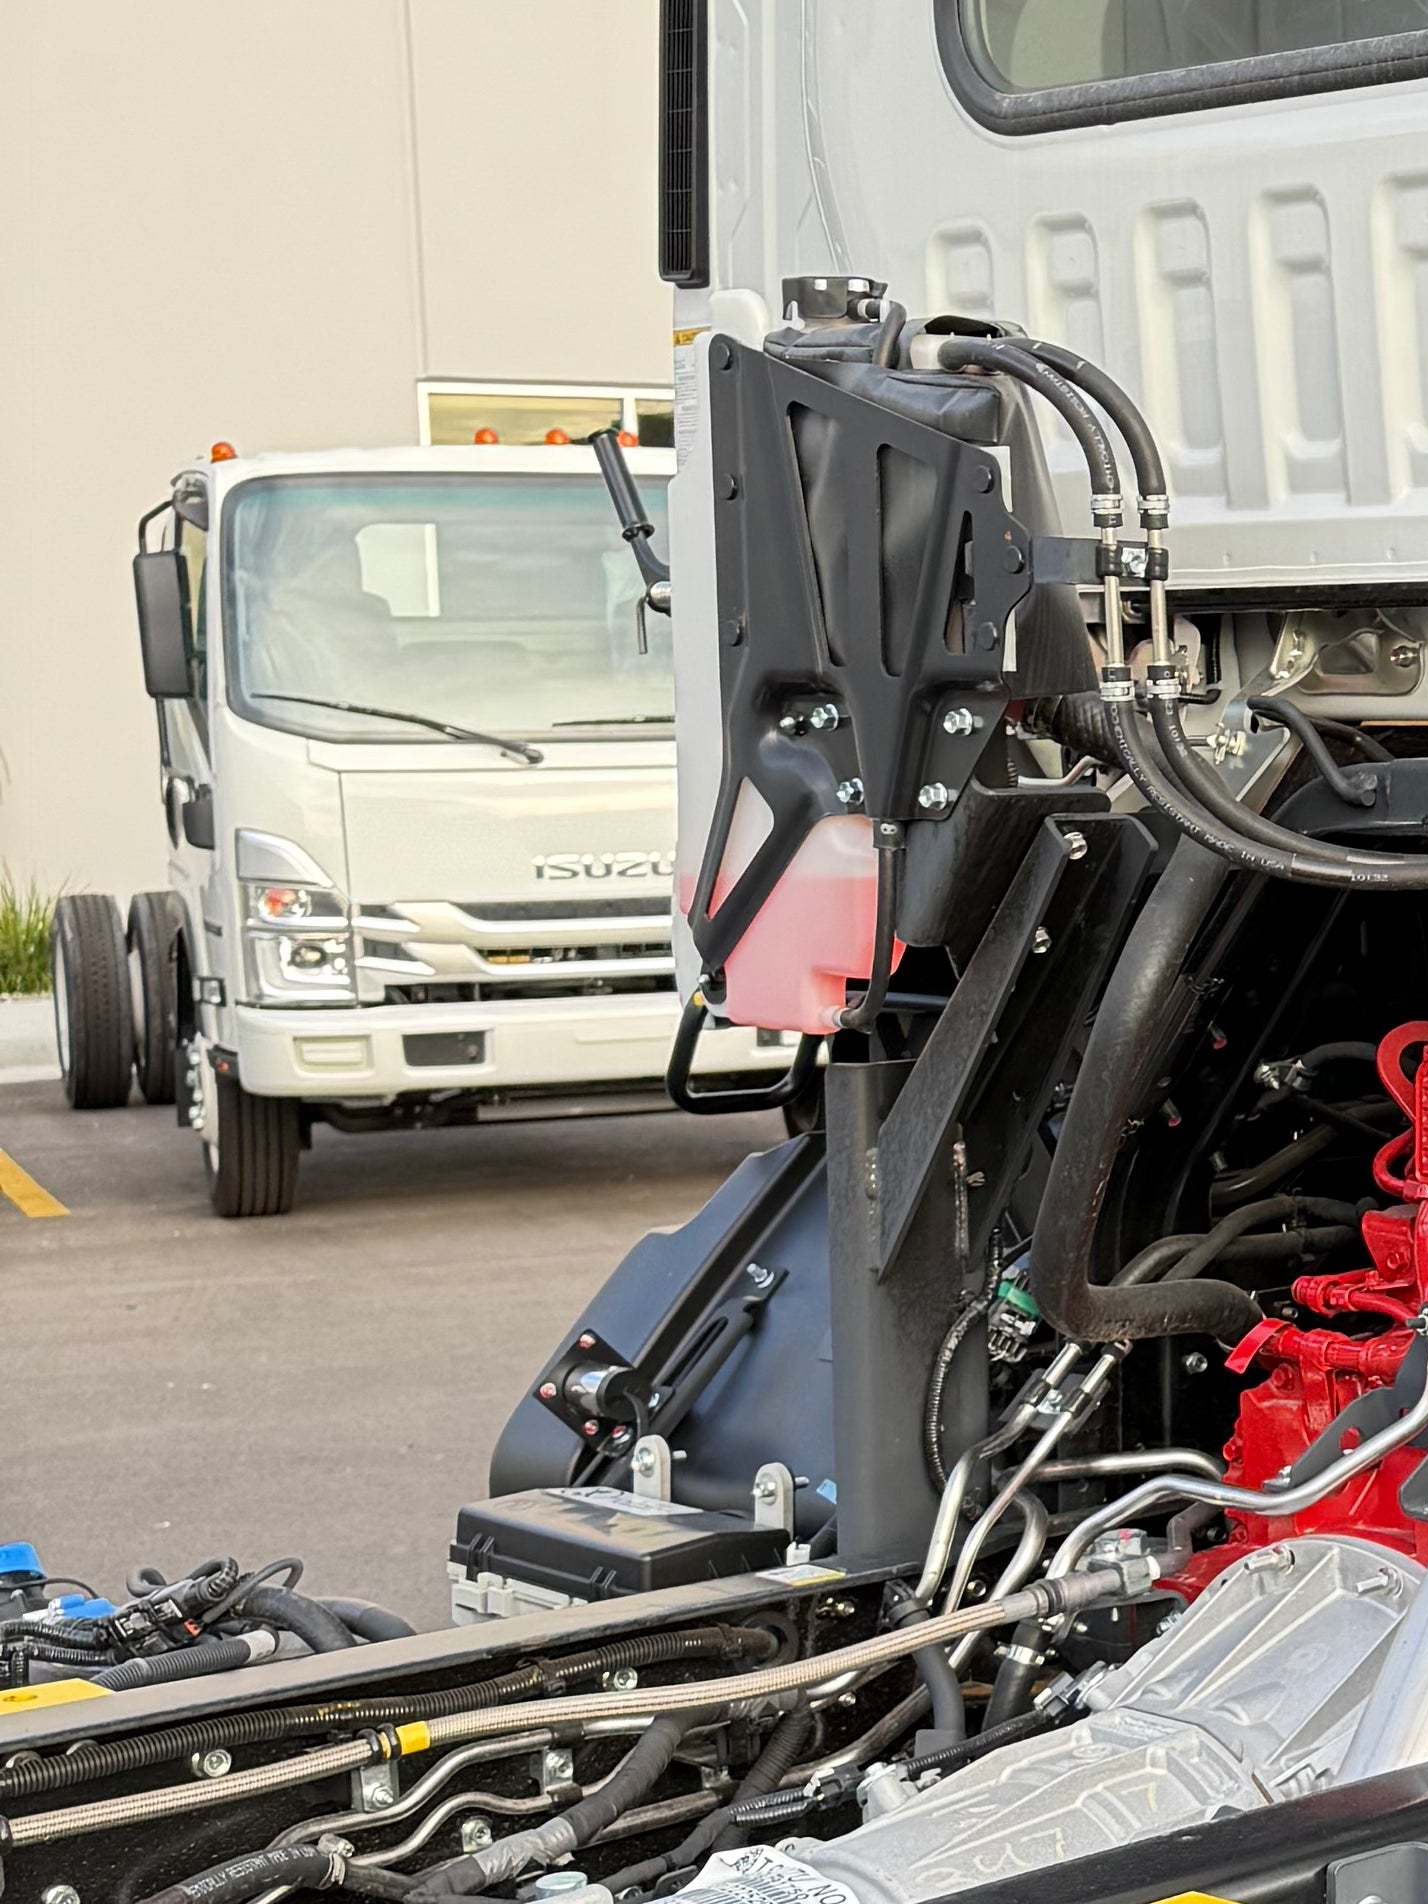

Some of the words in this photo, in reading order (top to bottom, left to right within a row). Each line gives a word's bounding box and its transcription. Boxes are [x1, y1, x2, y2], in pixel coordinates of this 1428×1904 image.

[532, 850, 677, 880] ISUZU
[1240, 852, 1256, 862] IN
[1260, 859, 1286, 870] USA
